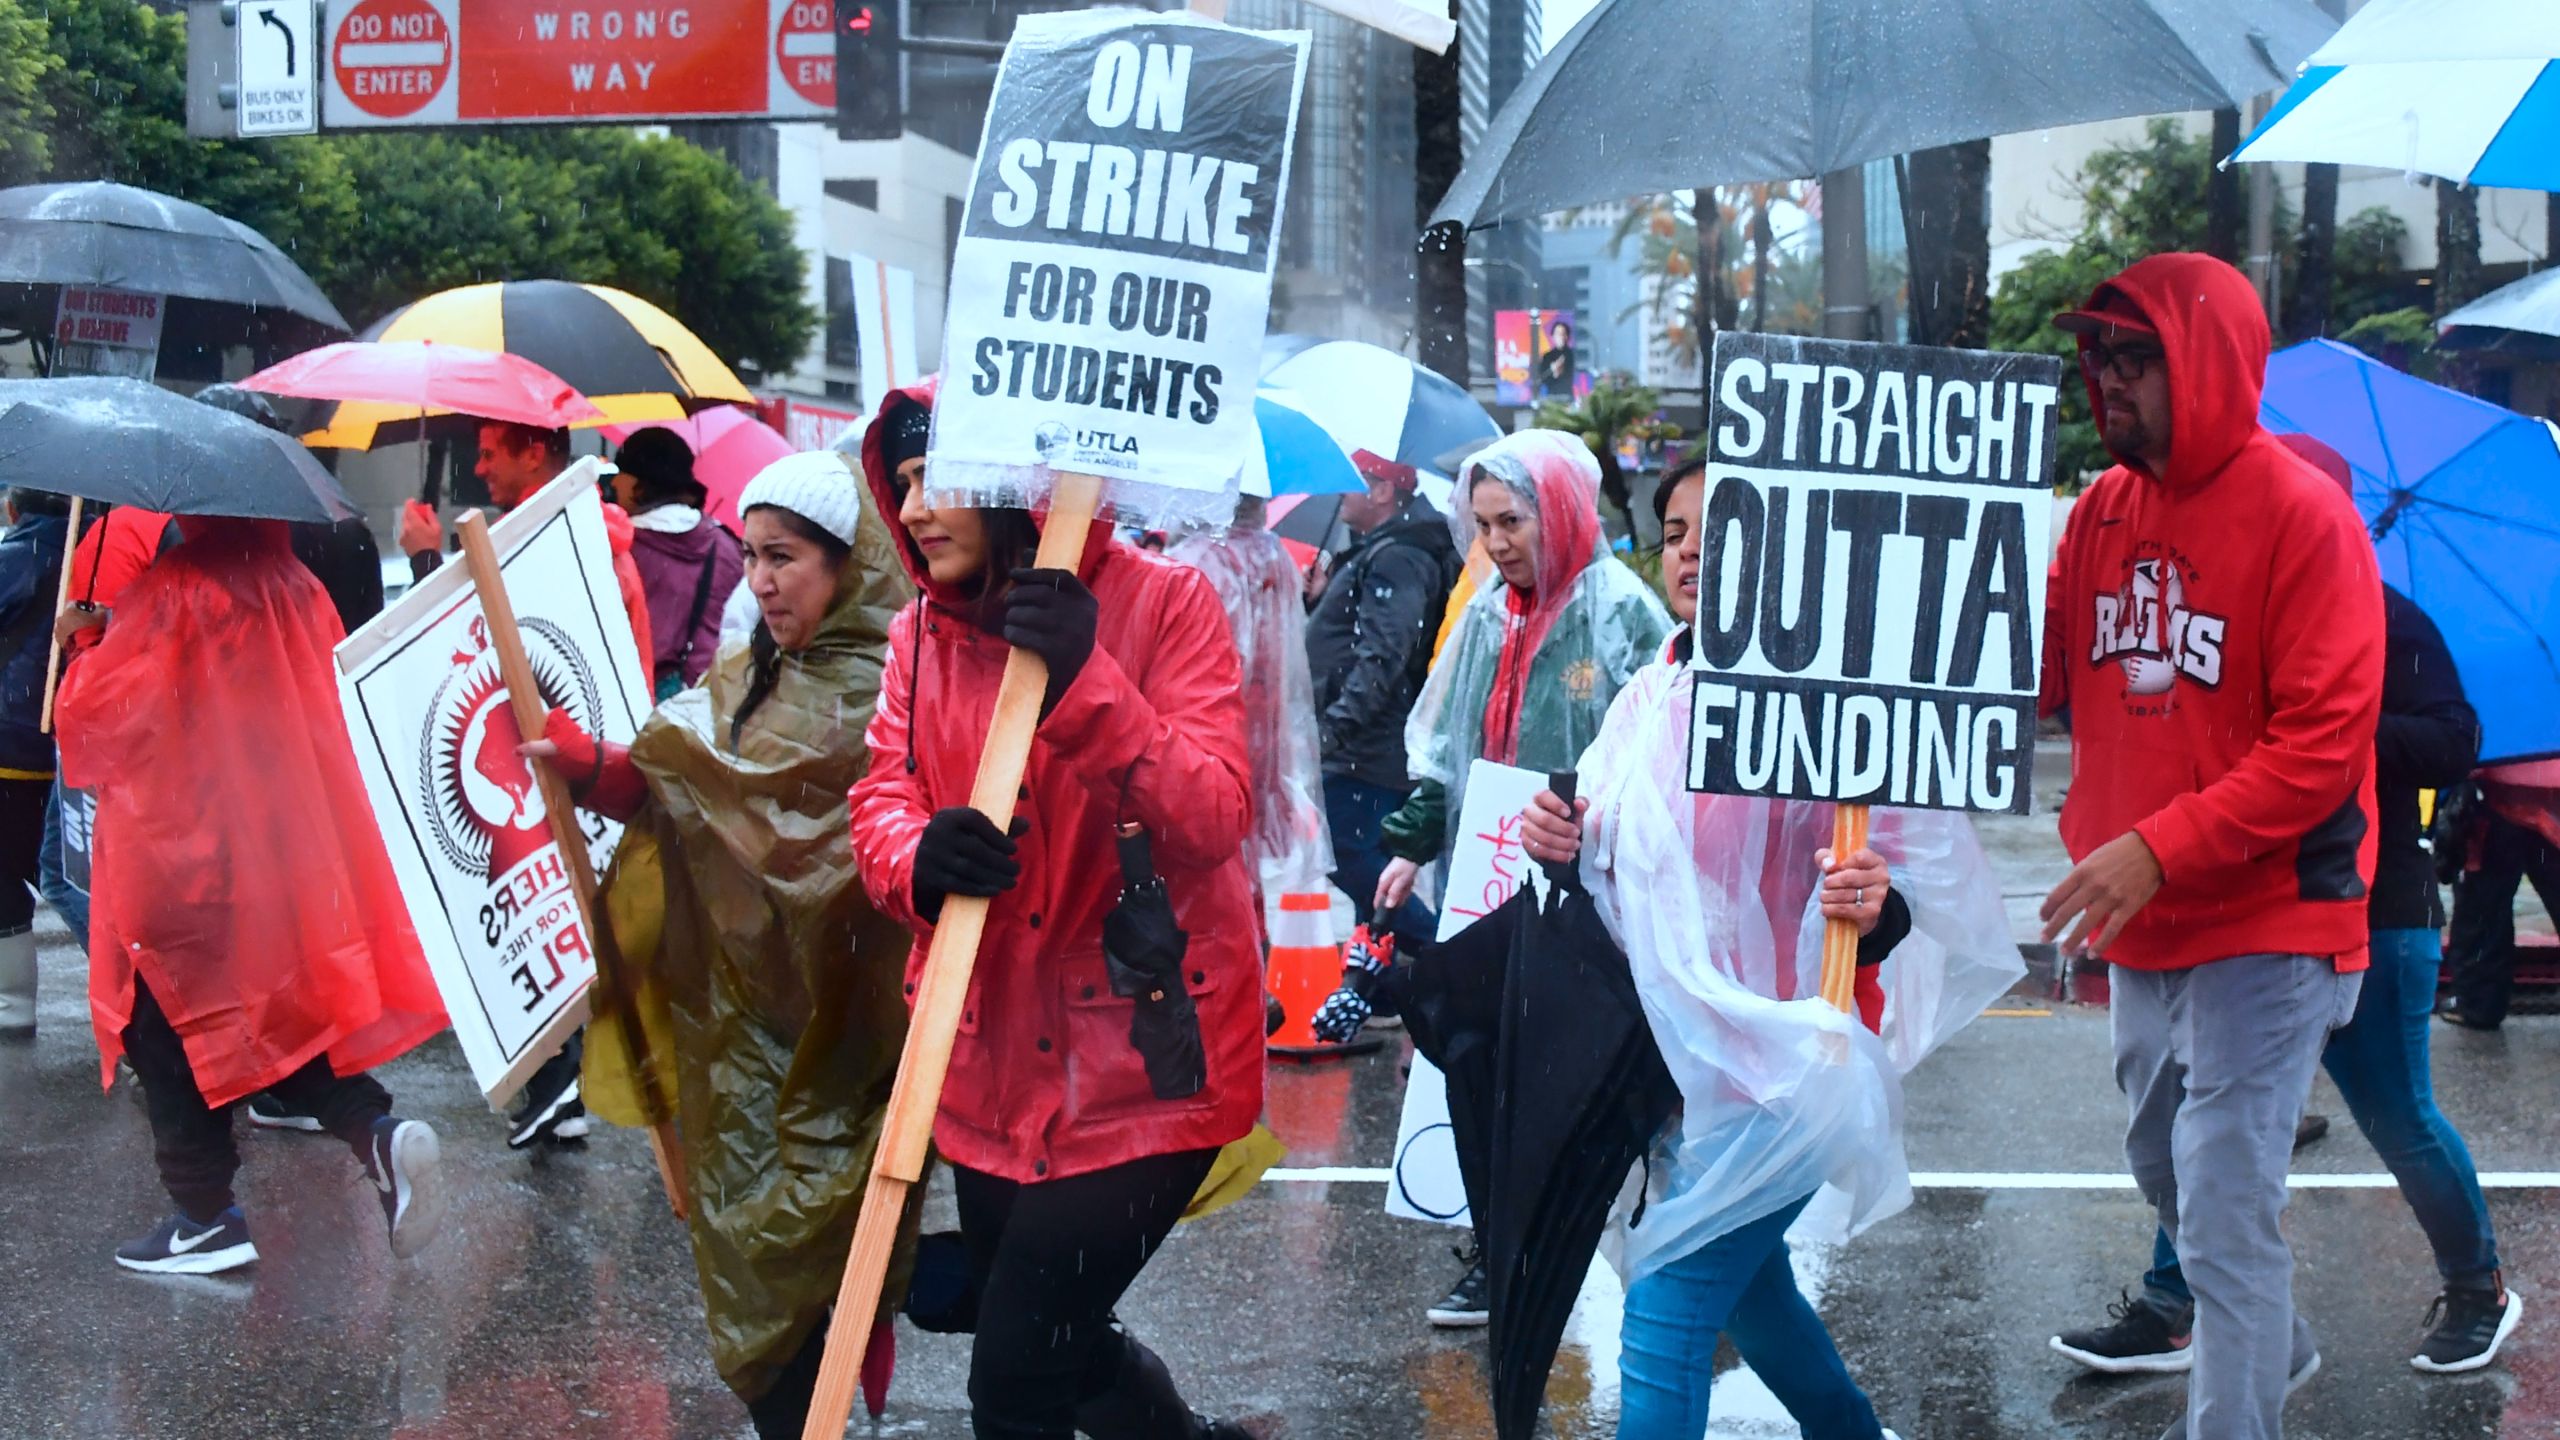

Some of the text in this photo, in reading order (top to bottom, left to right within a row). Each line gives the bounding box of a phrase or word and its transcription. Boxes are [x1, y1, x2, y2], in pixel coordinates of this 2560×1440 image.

[349, 14, 437, 40] DO NOT
[534, 9, 690, 41] WRONG
[793, 3, 828, 28] DO
[354, 70, 433, 96] ENTER
[569, 61, 656, 92] WAY
[1087, 40, 1193, 133] ON
[246, 89, 305, 106] BUS ONLY
[248, 108, 304, 126] BIKES OK
[992, 138, 1259, 254] STRIKE
[87, 291, 158, 319] STUDENTS
[1004, 262, 1212, 343] FOR OUR
[972, 337, 1222, 424] STUDENTS
[1717, 358, 2057, 483] STRAIGHT
[1076, 429, 1139, 455] UTLA
[1700, 476, 2036, 692] OUTTA
[1689, 682, 2018, 811] FUNDING
